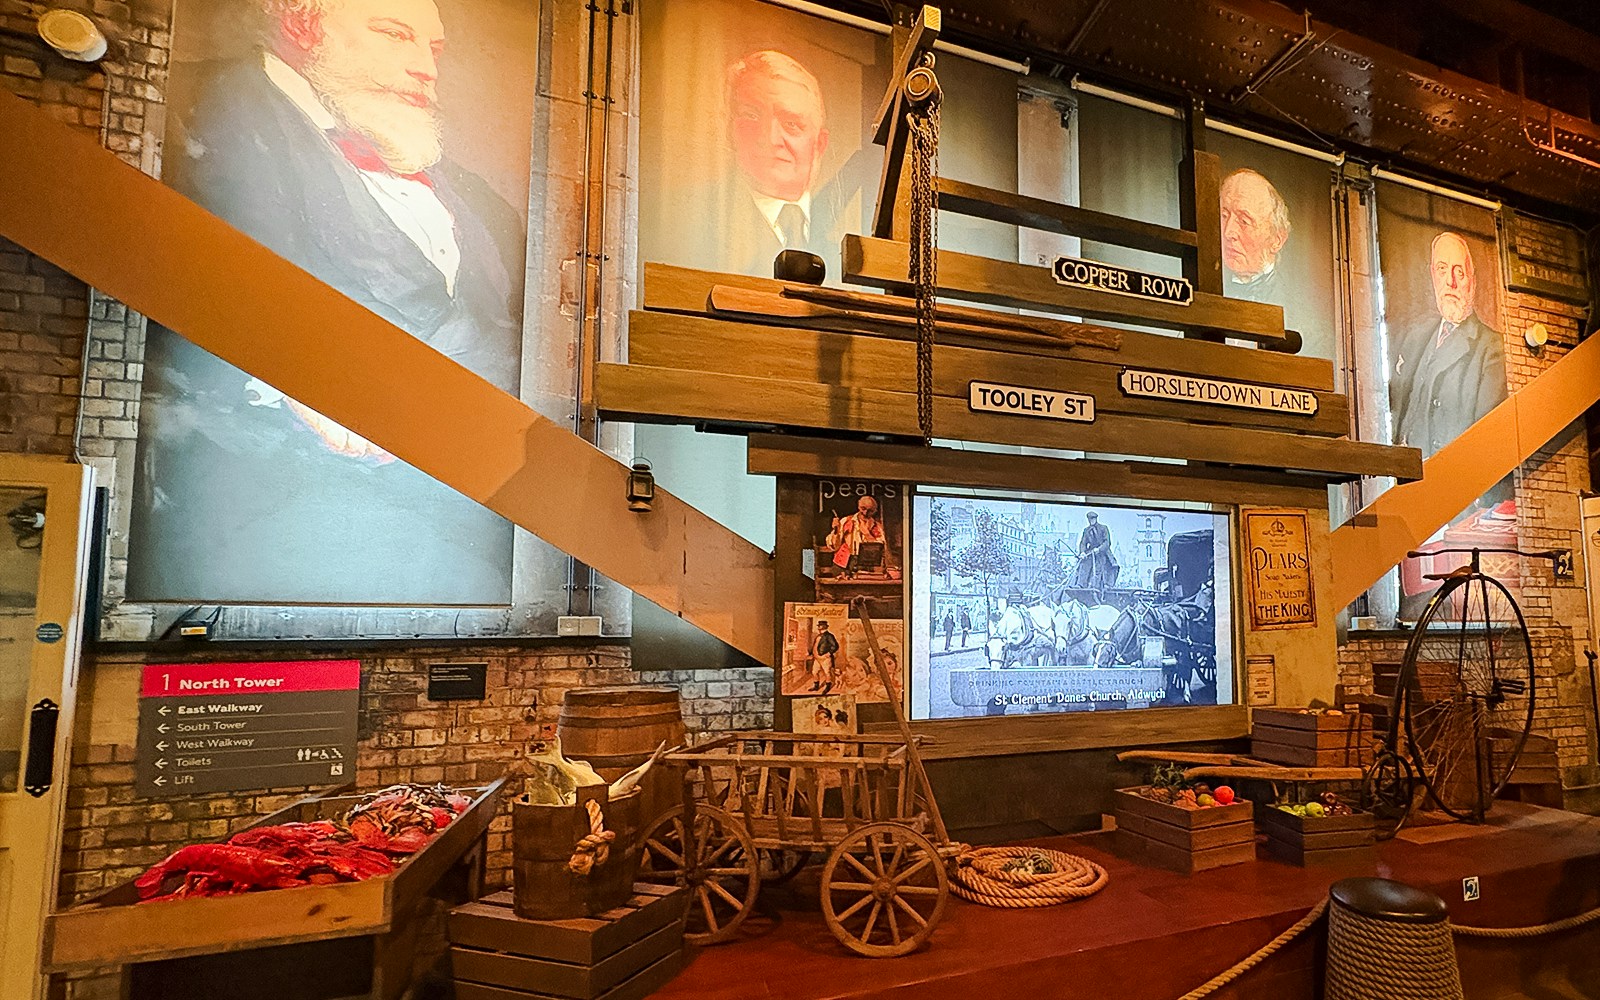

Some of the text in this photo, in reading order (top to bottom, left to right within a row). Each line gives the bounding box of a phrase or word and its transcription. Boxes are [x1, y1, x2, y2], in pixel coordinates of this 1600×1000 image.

[1061, 261, 1183, 299] COPPER ROW
[1129, 373, 1311, 411] HORSLEYDOWN LANE
[978, 387, 1087, 416] TOOLEY ST
[1258, 603, 1309, 618] THE KING
[162, 673, 284, 691] 1 North Tower
[994, 694, 1008, 706] St
[1011, 692, 1053, 705] Clement
[1056, 691, 1086, 703] Danes
[1128, 688, 1166, 702] Aldwych
[177, 703, 263, 715] East Walkway
[177, 720, 247, 732] South Tower
[176, 737, 255, 749] West Walkway
[175, 756, 212, 767] Toilets
[174, 775, 195, 785] Lift
